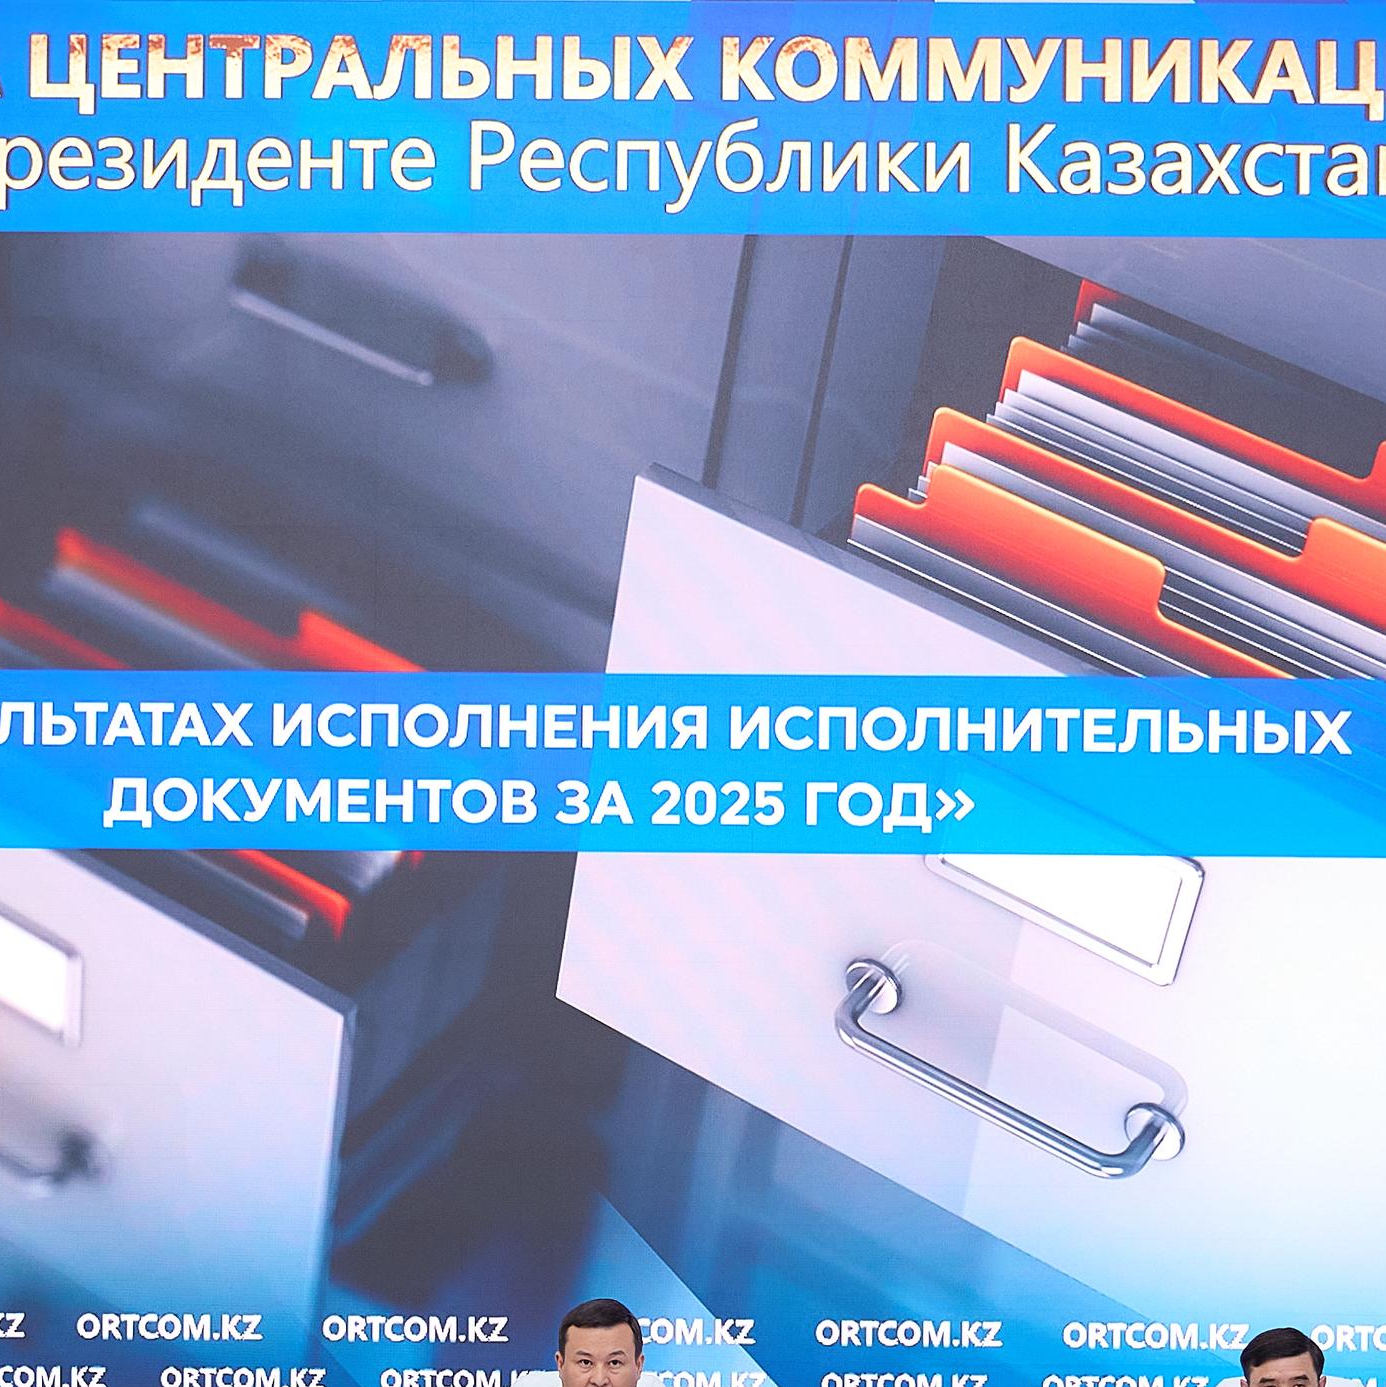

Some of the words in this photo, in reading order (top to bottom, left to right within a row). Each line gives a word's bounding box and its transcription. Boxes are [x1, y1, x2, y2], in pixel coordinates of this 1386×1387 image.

[29, 34, 694, 115] ЦЕНТРАЛЬНЫХ
[470, 119, 971, 214] Республики
[272, 704, 708, 750] ИСПОЛНЕНИЯ
[730, 706, 1352, 755] ИСПОЛНИТЕЛЬНЫХ
[103, 778, 538, 828] ДОКУМЕНТОВ
[555, 780, 634, 825] ЗА
[651, 781, 785, 826] 2025
[806, 782, 975, 834] ГОД»
[77, 1313, 263, 1341] ORTCOM.KZ
[323, 1315, 509, 1343] ORTCOM.KZ
[816, 1320, 1003, 1348] ORTCOM.KZ
[1063, 1322, 1250, 1350] ORTCOM.KZ
